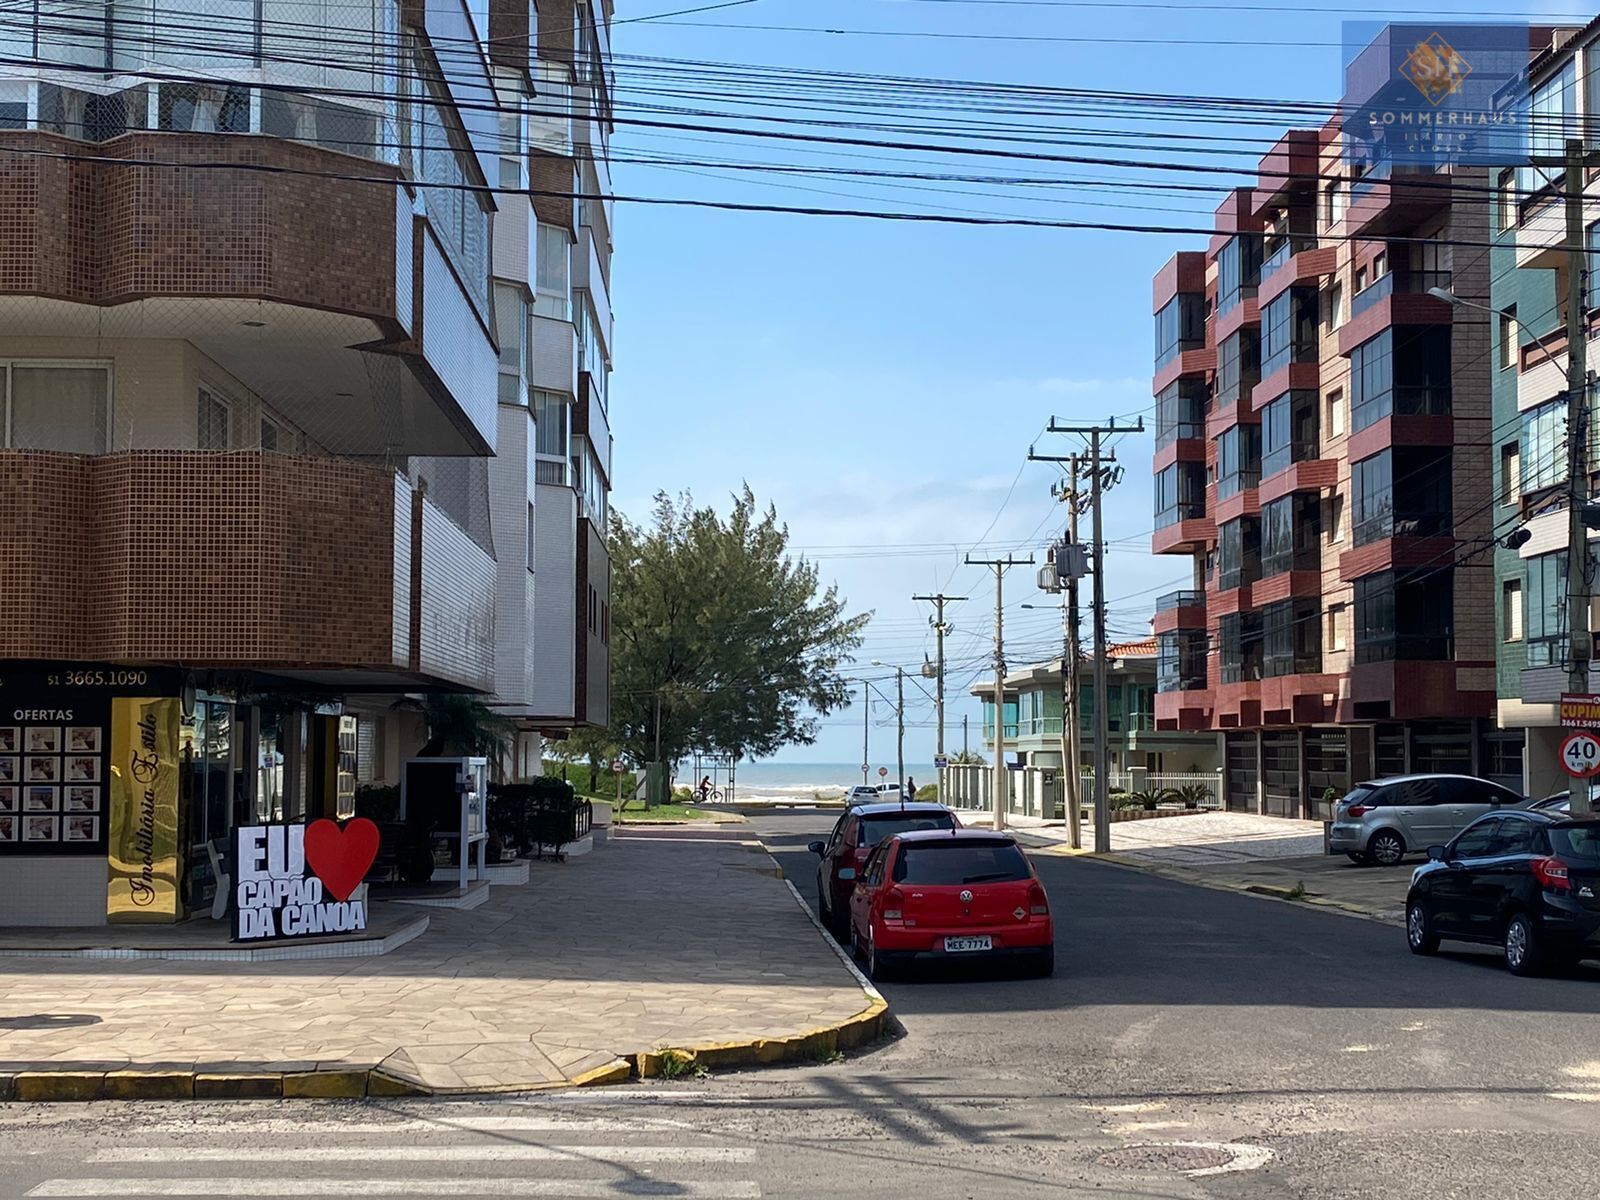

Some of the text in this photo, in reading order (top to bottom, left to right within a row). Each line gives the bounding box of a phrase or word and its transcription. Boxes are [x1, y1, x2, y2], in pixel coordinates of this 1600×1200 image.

[47, 670, 147, 686] 51 3665.1090
[13, 709, 74, 721] OFERTAS
[1567, 741, 1596, 759] 40
[238, 824, 305, 883] EU
[238, 874, 322, 909] CAPÃO
[239, 901, 366, 939] DA CANOA
